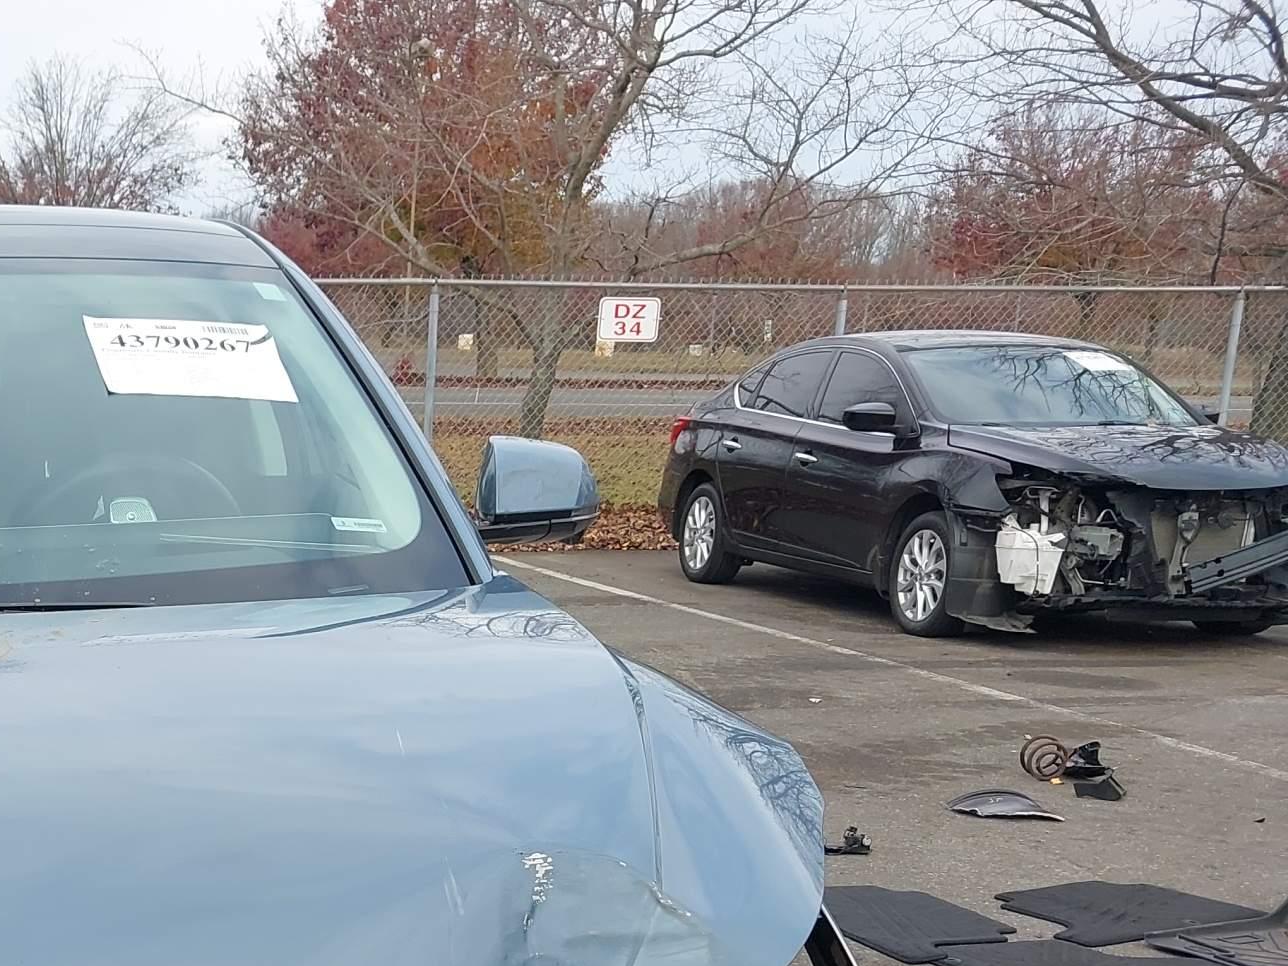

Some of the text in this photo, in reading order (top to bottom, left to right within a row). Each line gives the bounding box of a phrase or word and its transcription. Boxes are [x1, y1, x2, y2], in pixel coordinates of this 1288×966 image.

[614, 303, 647, 319] DZ
[613, 321, 643, 336] 34
[109, 333, 251, 353] 43790267
